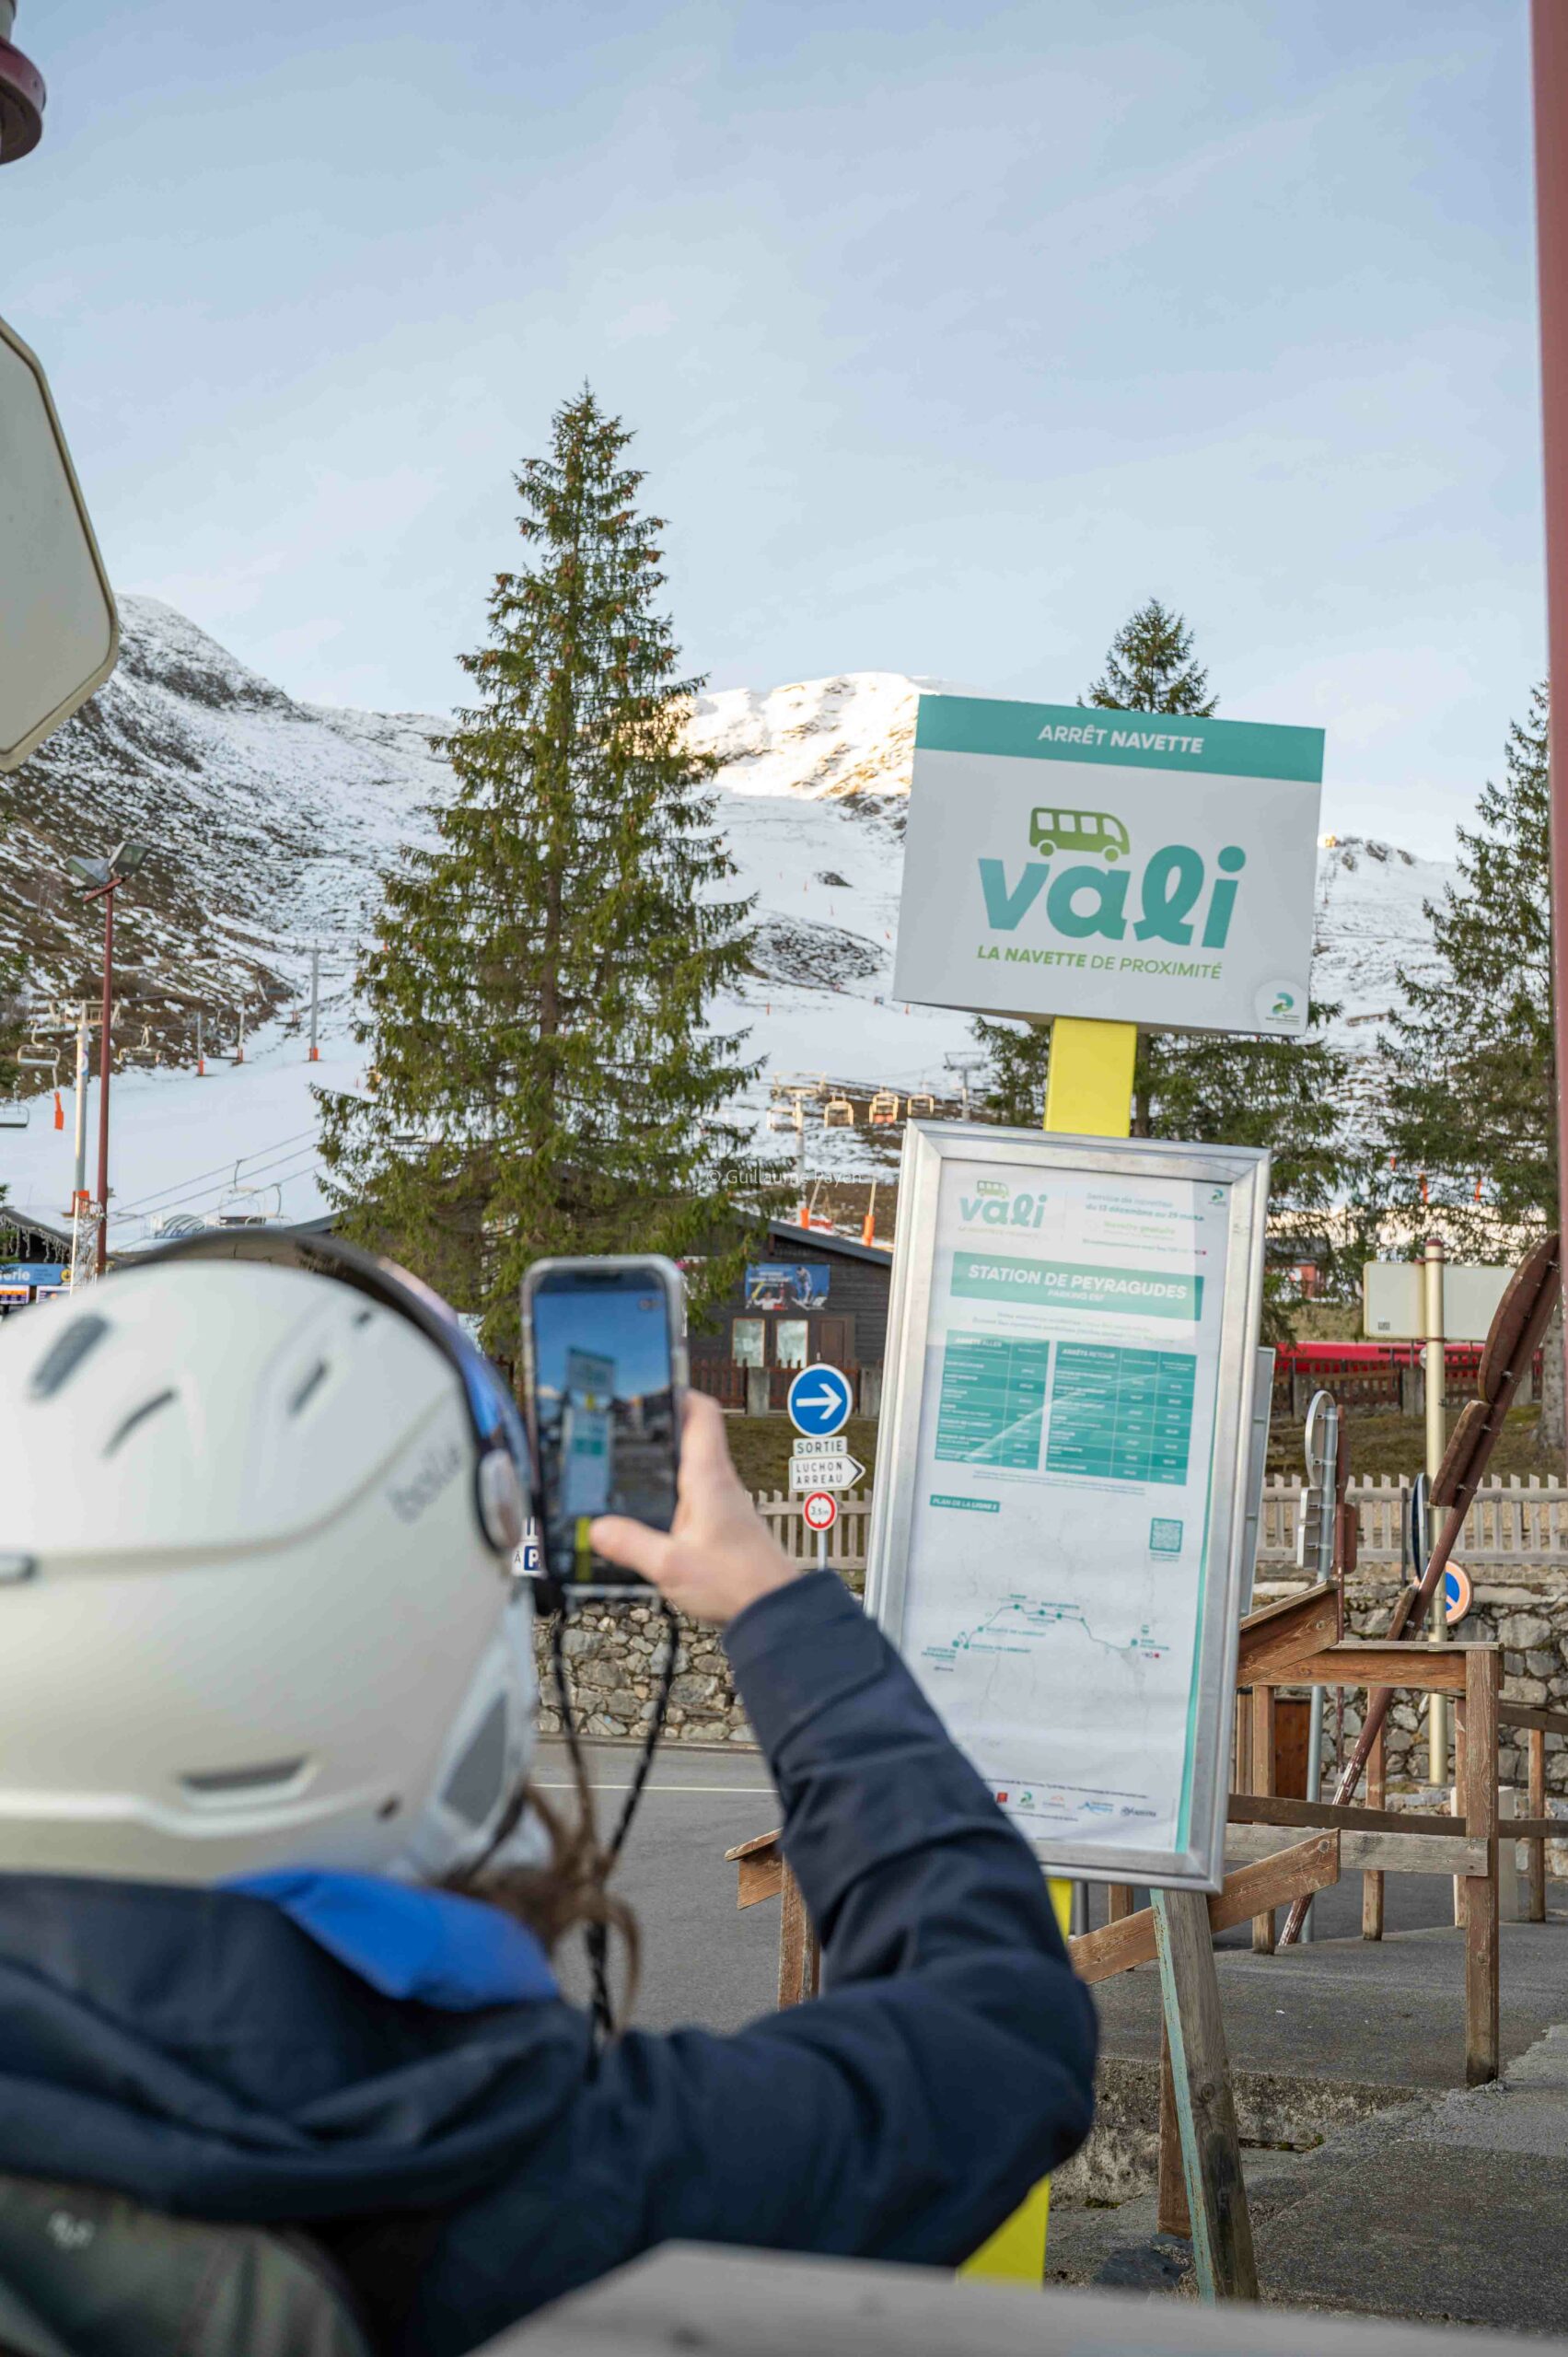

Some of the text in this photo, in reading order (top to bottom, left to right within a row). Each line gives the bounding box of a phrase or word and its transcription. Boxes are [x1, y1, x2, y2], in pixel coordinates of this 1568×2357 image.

[1037, 724, 1204, 754] ARRÊT NAVETTE
[978, 844, 1246, 949] vali
[977, 945, 1223, 980] LA NAVETTE DE PROXIMITÉ
[959, 1193, 1048, 1228] vali
[968, 1263, 1188, 1300] STATION DE PEYRAGUDES
[796, 1440, 843, 1454] SORTIE
[796, 1461, 842, 1473] LUCHON
[796, 1474, 842, 1485] ARREAU
